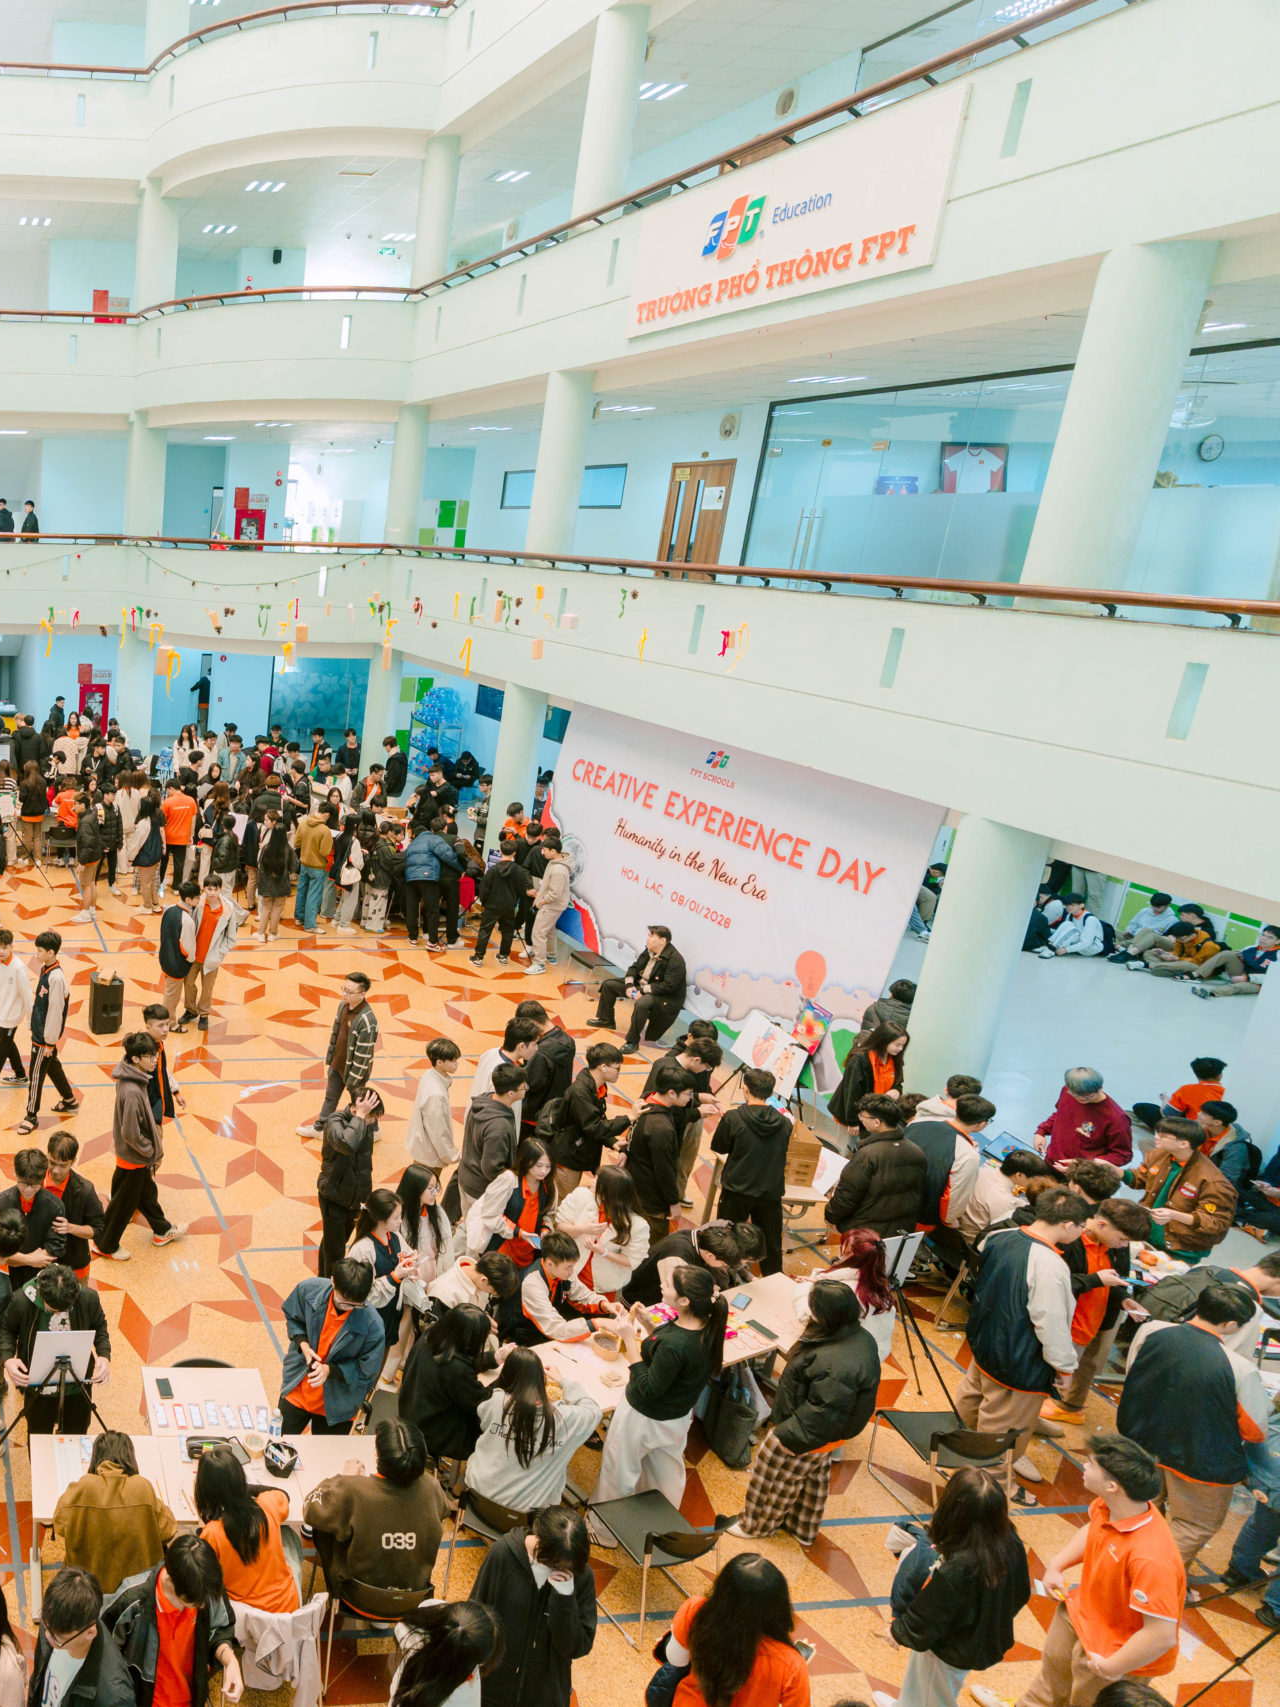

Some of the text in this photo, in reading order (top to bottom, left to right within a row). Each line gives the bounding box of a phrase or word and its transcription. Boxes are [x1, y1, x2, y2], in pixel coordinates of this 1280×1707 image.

[701, 192, 832, 260] FPT Education
[766, 242, 852, 289] THÔNG
[858, 224, 916, 265] FPT
[703, 772, 736, 789] SCHOOLS
[572, 759, 886, 895] CREATIVE EXPERIENCE DAY
[614, 818, 767, 901] Humanity in the New Era
[621, 866, 639, 885] HOA
[381, 1532, 417, 1550] 039
